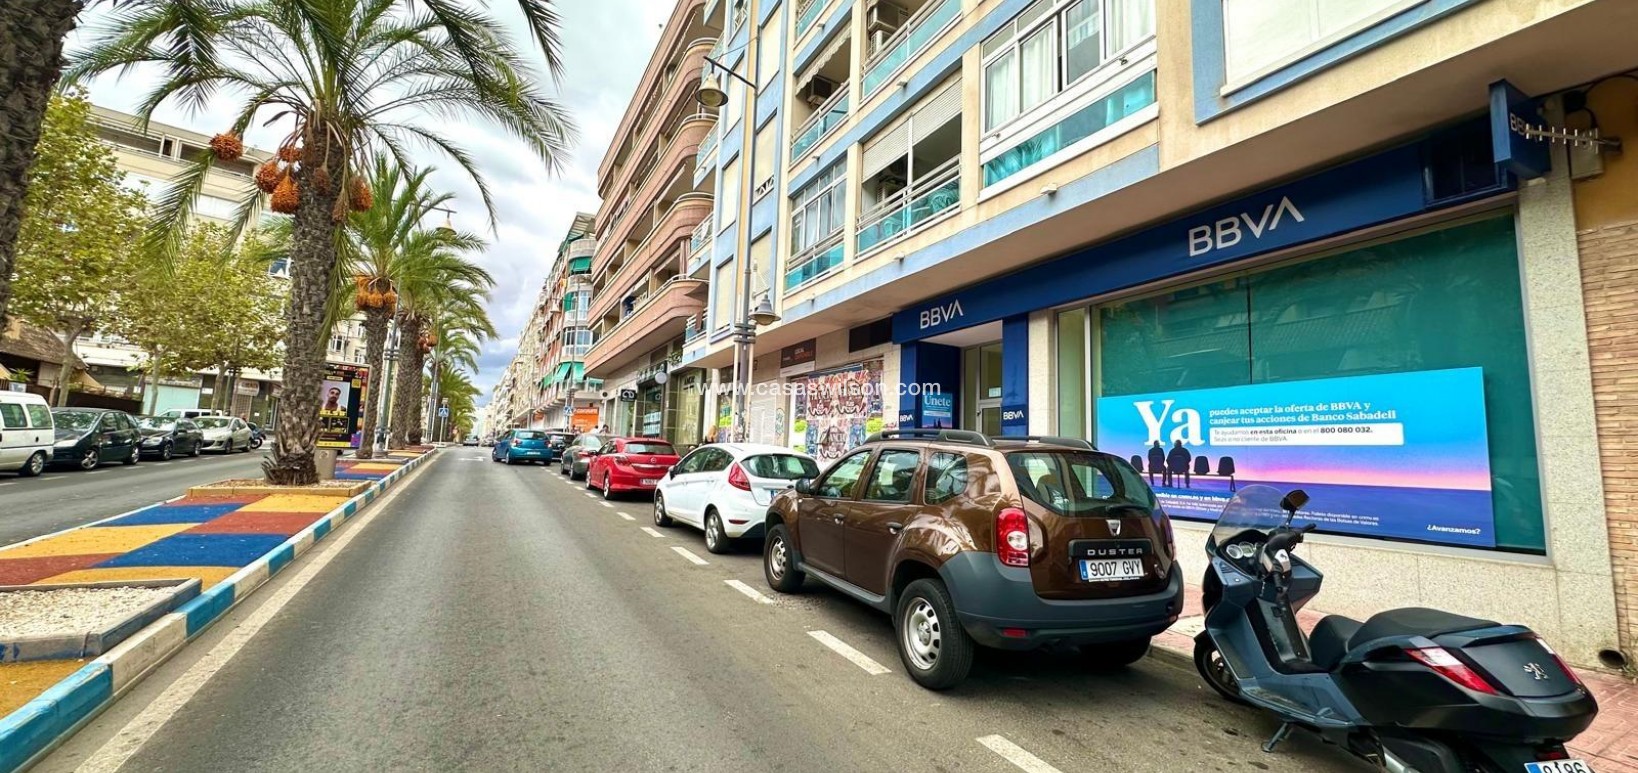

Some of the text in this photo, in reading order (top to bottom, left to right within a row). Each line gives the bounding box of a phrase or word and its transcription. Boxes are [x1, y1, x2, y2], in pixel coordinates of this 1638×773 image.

[1188, 195, 1305, 257] BBVA
[919, 299, 964, 329] BBVA
[1003, 410, 1024, 421] BBVA
[1209, 401, 1371, 417] puedes aceptar la oferta de BBVA y
[1133, 399, 1205, 446] Ya
[1209, 410, 1396, 425] canjear tus acciones de Banco Sabadell
[1320, 426, 1336, 434] 800
[1426, 524, 1481, 535] ¿Avanzamos?
[1087, 548, 1143, 556] DUSTER
[1090, 560, 1141, 576] 9007 GVY
